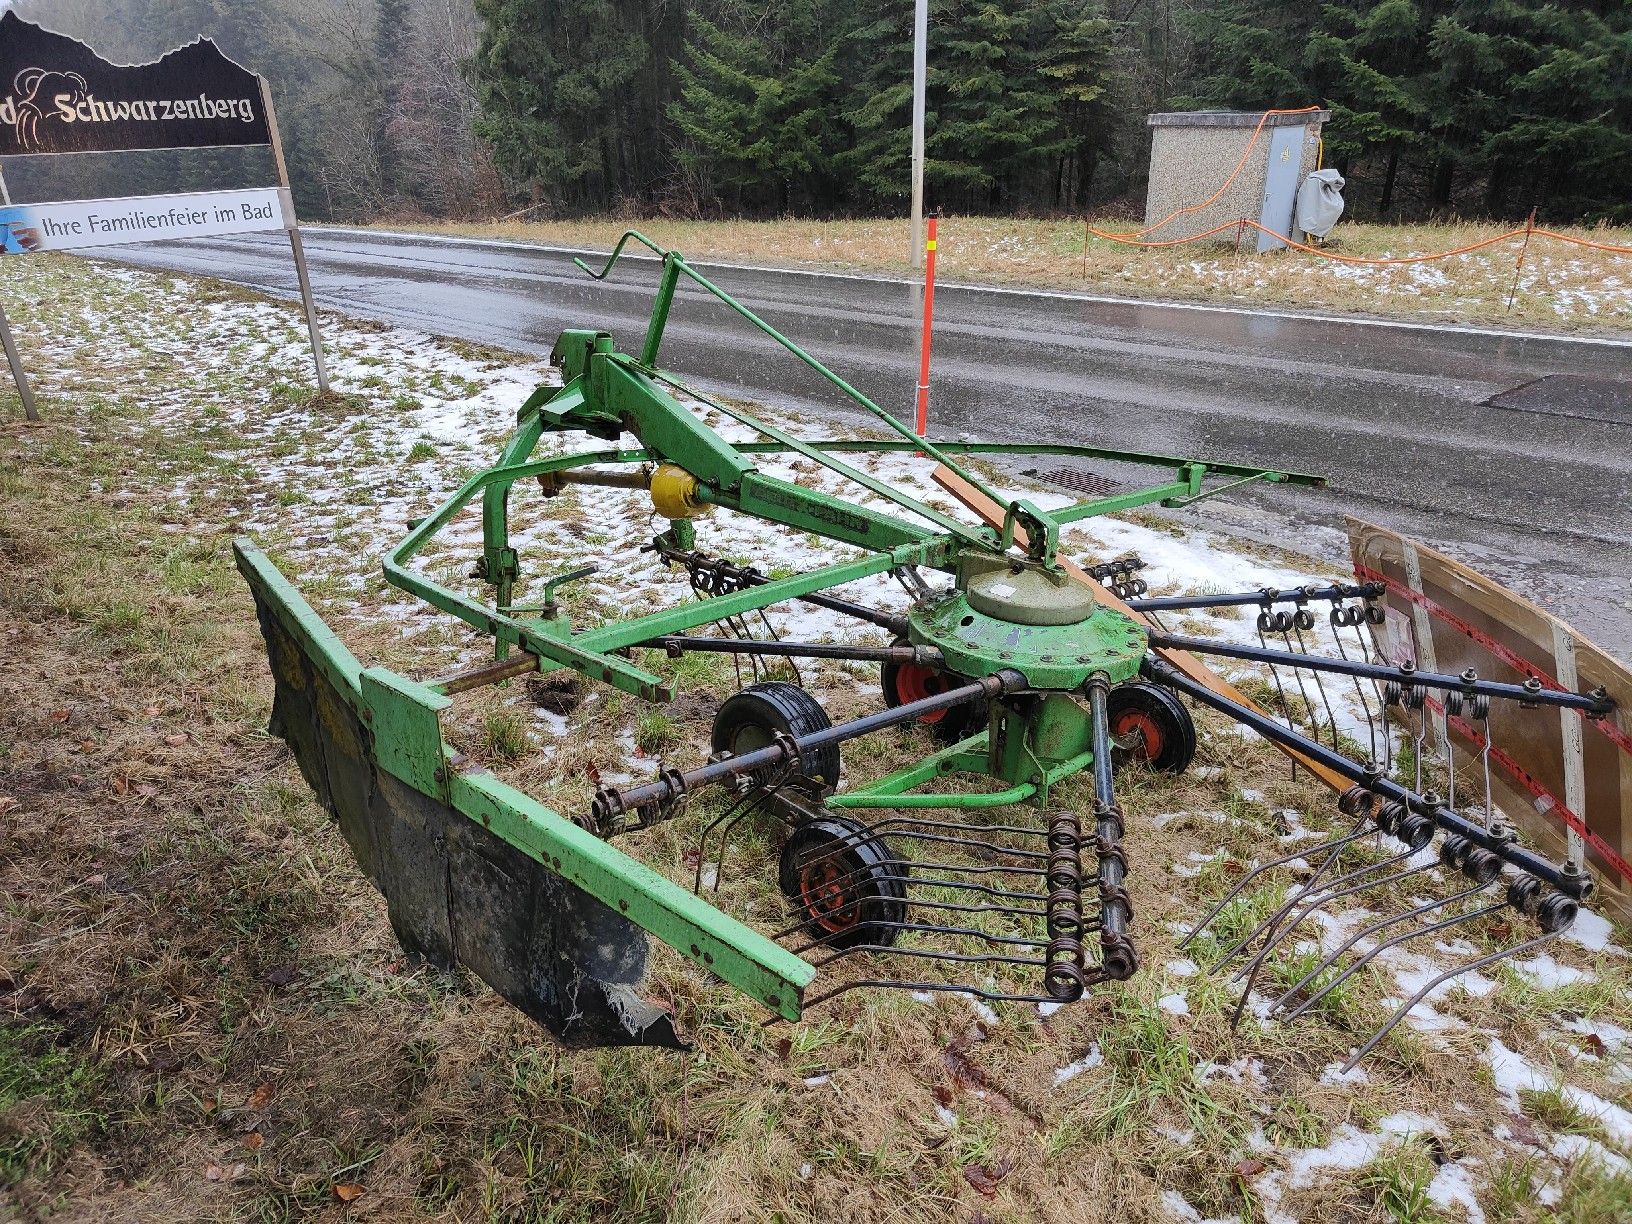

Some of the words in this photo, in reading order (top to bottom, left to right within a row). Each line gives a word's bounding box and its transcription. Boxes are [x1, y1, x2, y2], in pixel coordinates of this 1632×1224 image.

[54, 93, 255, 123] Schwarzenberg
[42, 217, 82, 236] Ihre
[87, 207, 208, 233] Familienfeier
[213, 205, 236, 223] im
[240, 201, 273, 221] Bad
